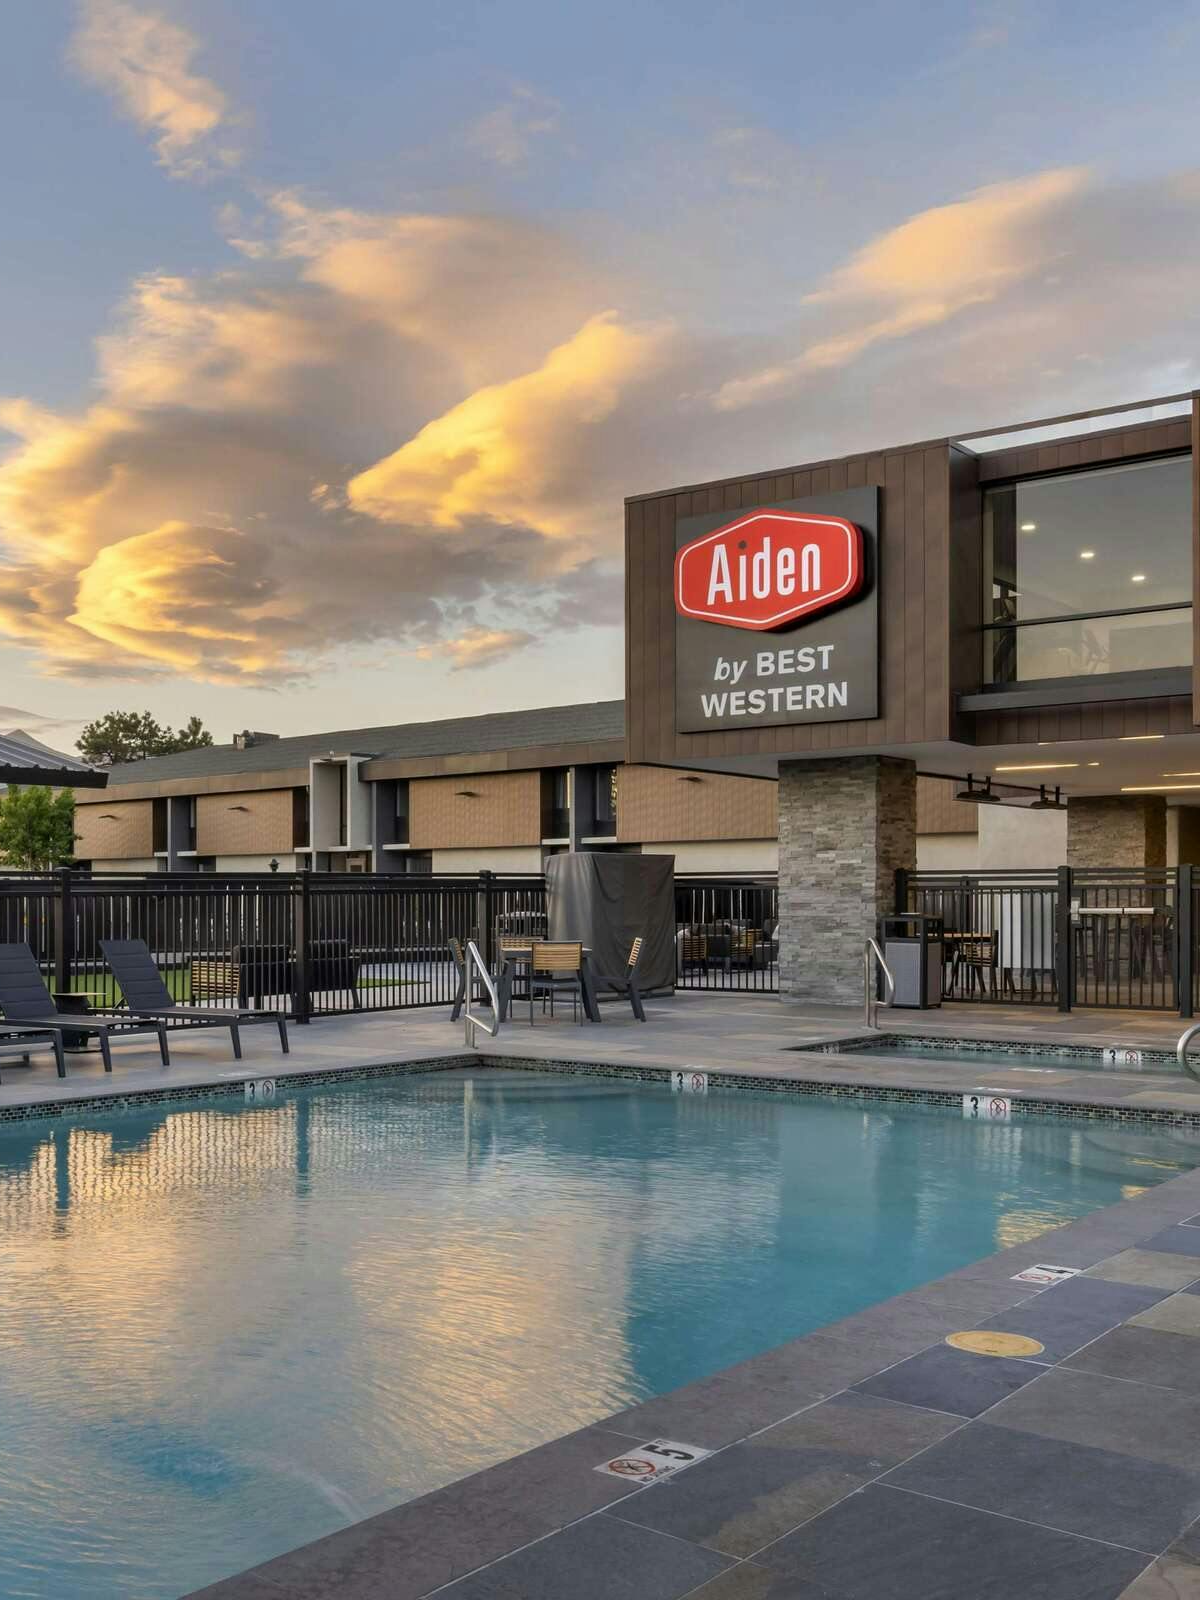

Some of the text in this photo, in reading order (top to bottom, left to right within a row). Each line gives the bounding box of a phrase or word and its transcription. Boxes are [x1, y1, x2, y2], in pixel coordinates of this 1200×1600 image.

[706, 536, 821, 606] Aiden
[714, 645, 834, 685] by BEST
[701, 681, 848, 718] WESTERN
[641, 1443, 695, 1461] 5
